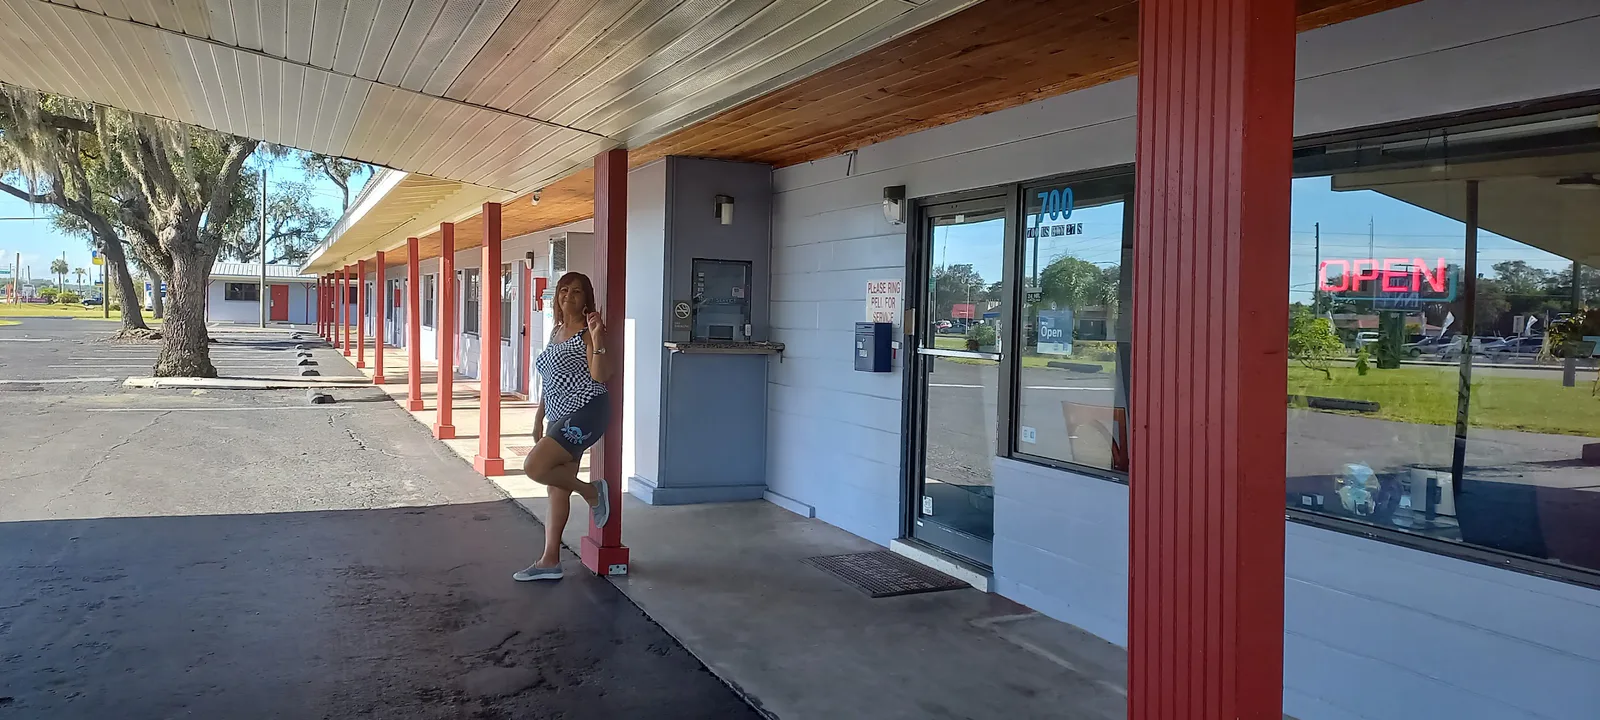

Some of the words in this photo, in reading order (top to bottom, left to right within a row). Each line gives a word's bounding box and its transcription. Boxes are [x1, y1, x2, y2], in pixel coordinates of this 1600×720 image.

[1038, 188, 1074, 223] 700
[1027, 228, 1038, 238] 700
[1041, 226, 1049, 237] US
[1066, 223, 1075, 235] 27
[1077, 222, 1083, 234] S
[1320, 257, 1445, 292] OPEN
[868, 282, 886, 293] PLEASE
[888, 281, 900, 293] RING
[885, 297, 895, 308] FOR
[1040, 325, 1062, 340] Open
